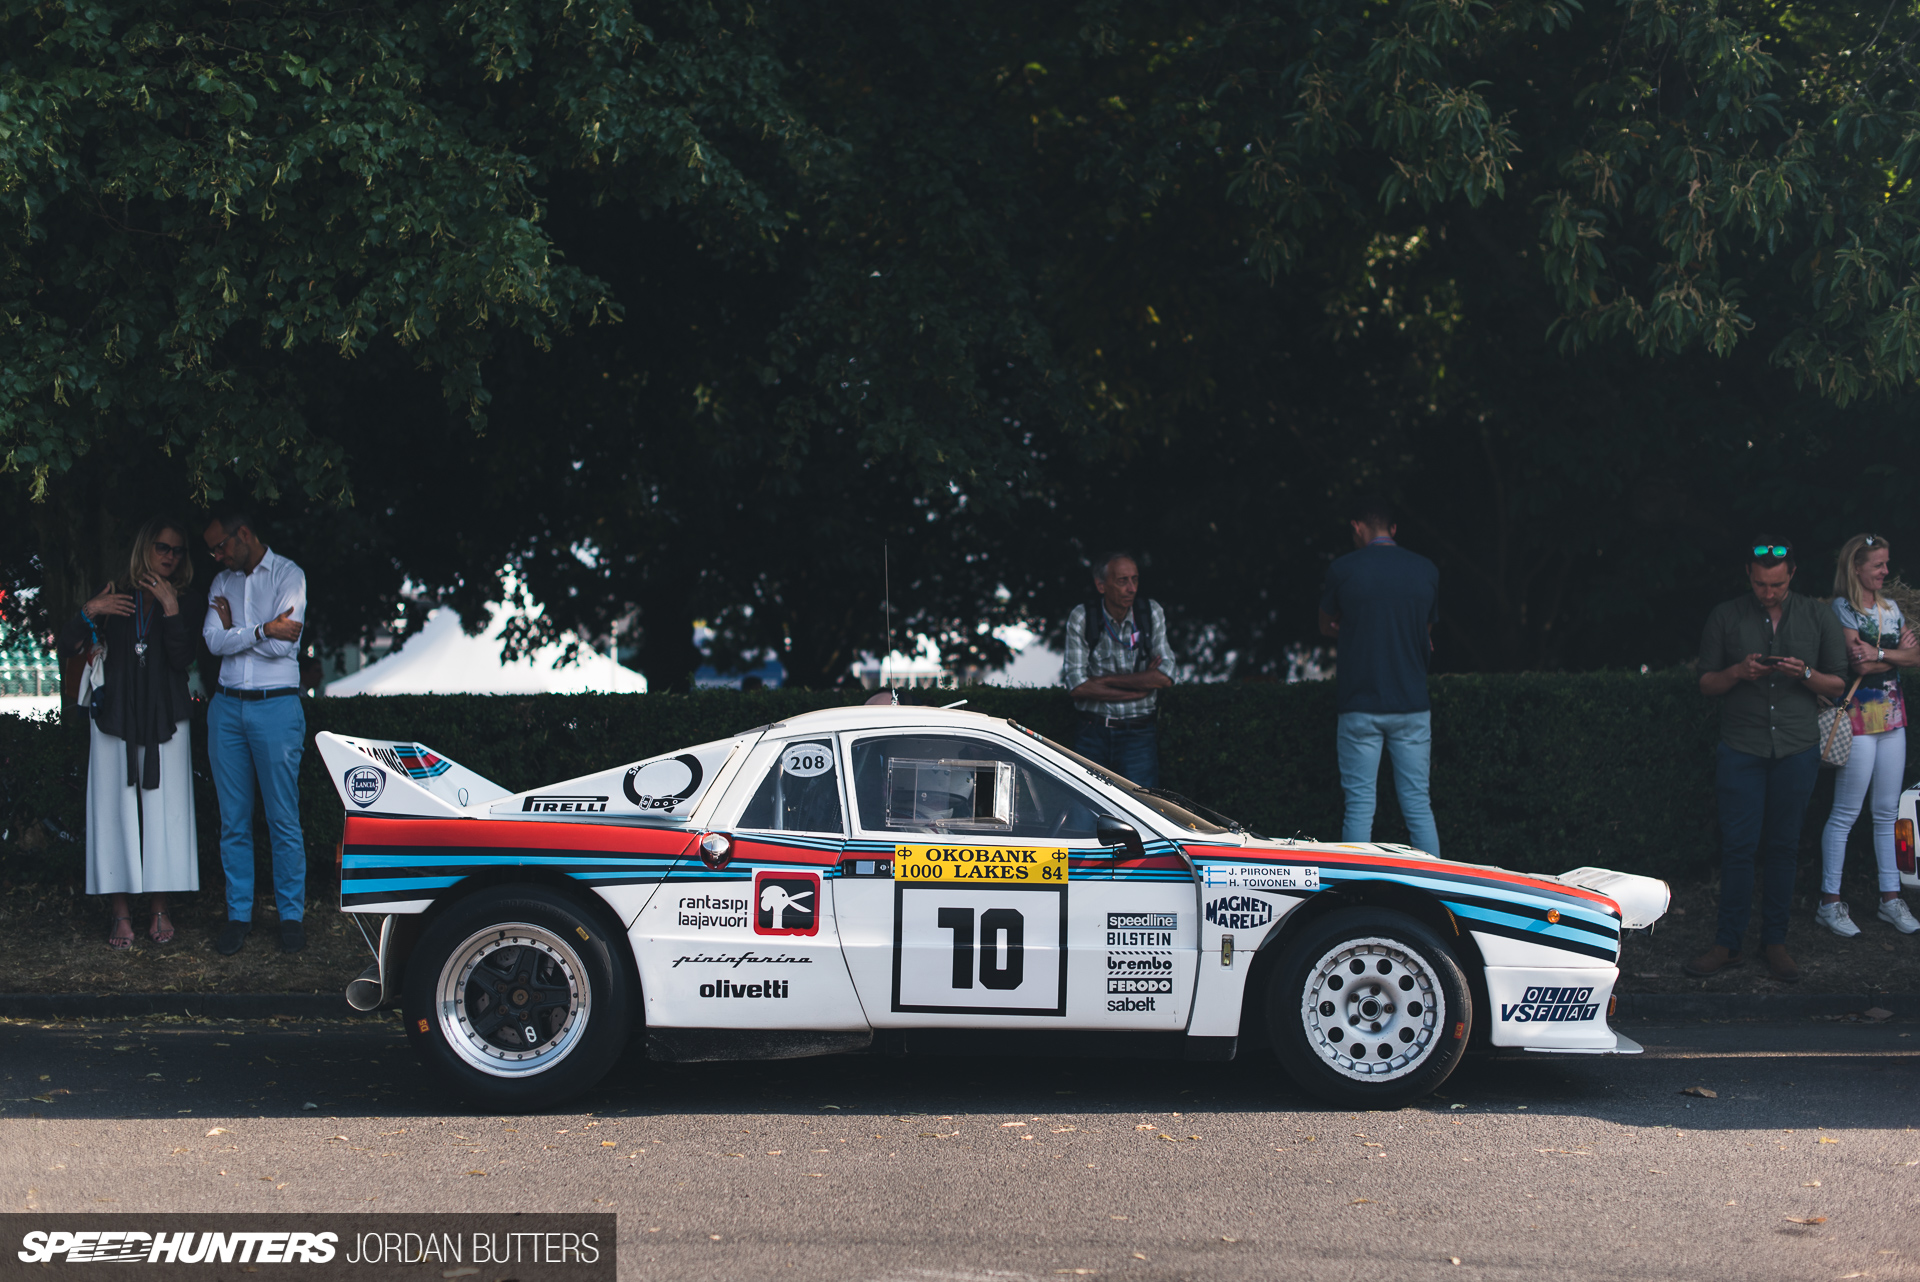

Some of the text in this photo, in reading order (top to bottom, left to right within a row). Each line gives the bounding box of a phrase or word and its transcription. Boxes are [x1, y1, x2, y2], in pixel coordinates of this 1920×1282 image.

[791, 756, 825, 770] 208
[522, 795, 609, 812] PIRELLI
[925, 848, 1037, 863] OKOBANK
[900, 864, 1063, 880] 1000 LAKES 84
[1228, 868, 1238, 876] J.
[1240, 868, 1291, 876] PIIRONEN
[1242, 879, 1297, 888] TOIVONEN
[678, 894, 748, 913] rantasipi
[1205, 895, 1272, 915] MAGNETI
[678, 911, 748, 929] laajavuori
[1109, 913, 1174, 929] speedline
[1205, 910, 1272, 929] MARELLI
[1107, 932, 1171, 946] BILSTEIN
[937, 907, 1024, 990] 10
[672, 952, 813, 968] pininfarina
[1107, 956, 1172, 970] brembo
[699, 979, 788, 998] olivetti
[1108, 980, 1171, 992] FERODO
[1525, 987, 1591, 1002] OLIO
[1107, 996, 1156, 1011] sabelt
